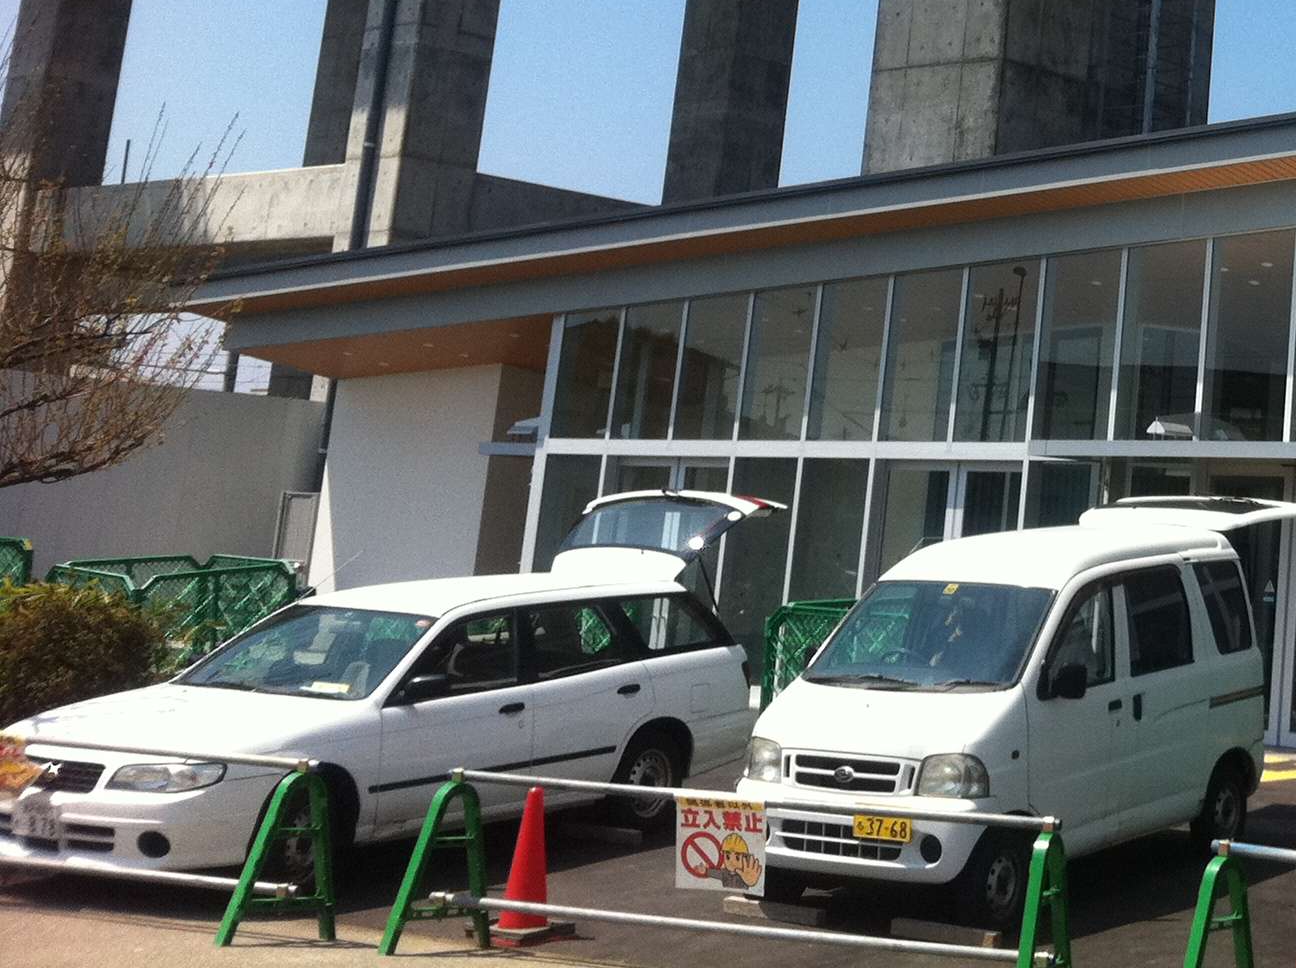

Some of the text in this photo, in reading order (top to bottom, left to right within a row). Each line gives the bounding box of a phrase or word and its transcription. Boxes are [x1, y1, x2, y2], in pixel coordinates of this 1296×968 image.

[680, 808, 764, 834] 立入禁止
[866, 818, 908, 839] 37-68
